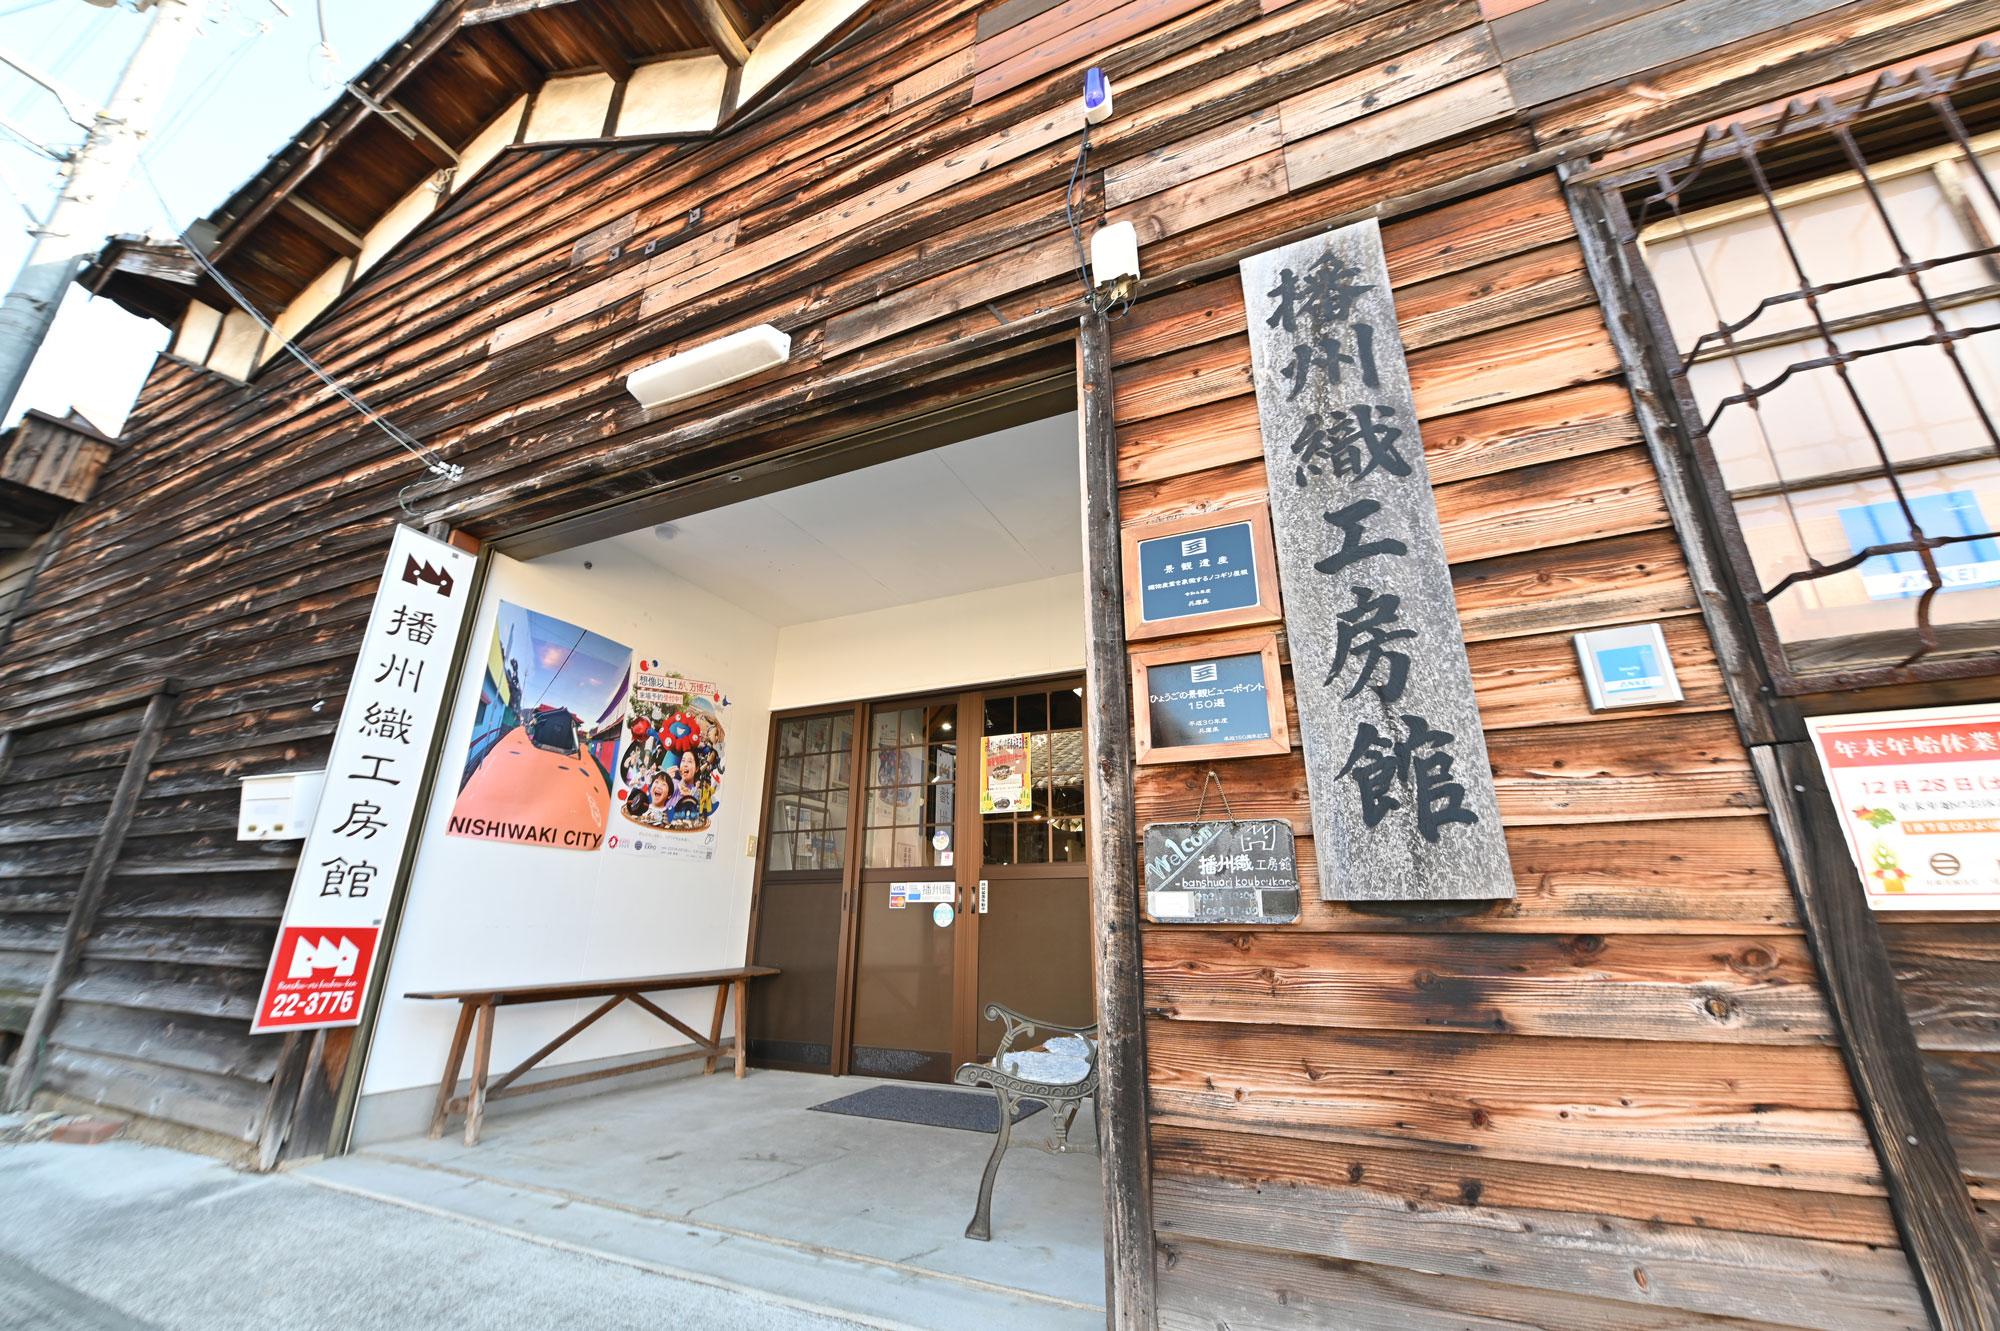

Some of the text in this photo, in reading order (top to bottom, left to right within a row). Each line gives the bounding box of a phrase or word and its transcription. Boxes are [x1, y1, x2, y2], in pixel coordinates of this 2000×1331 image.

[1266, 249, 1479, 843] 播州織工房館
[1149, 682, 1265, 704] ひょうごの景観ビューポイント
[1188, 699, 1226, 710] 150選
[318, 604, 439, 899] 播州織工房館
[1834, 731, 2000, 759] 年末年始休業
[449, 815, 557, 844] NISHIWAKI
[563, 829, 603, 848] CITY
